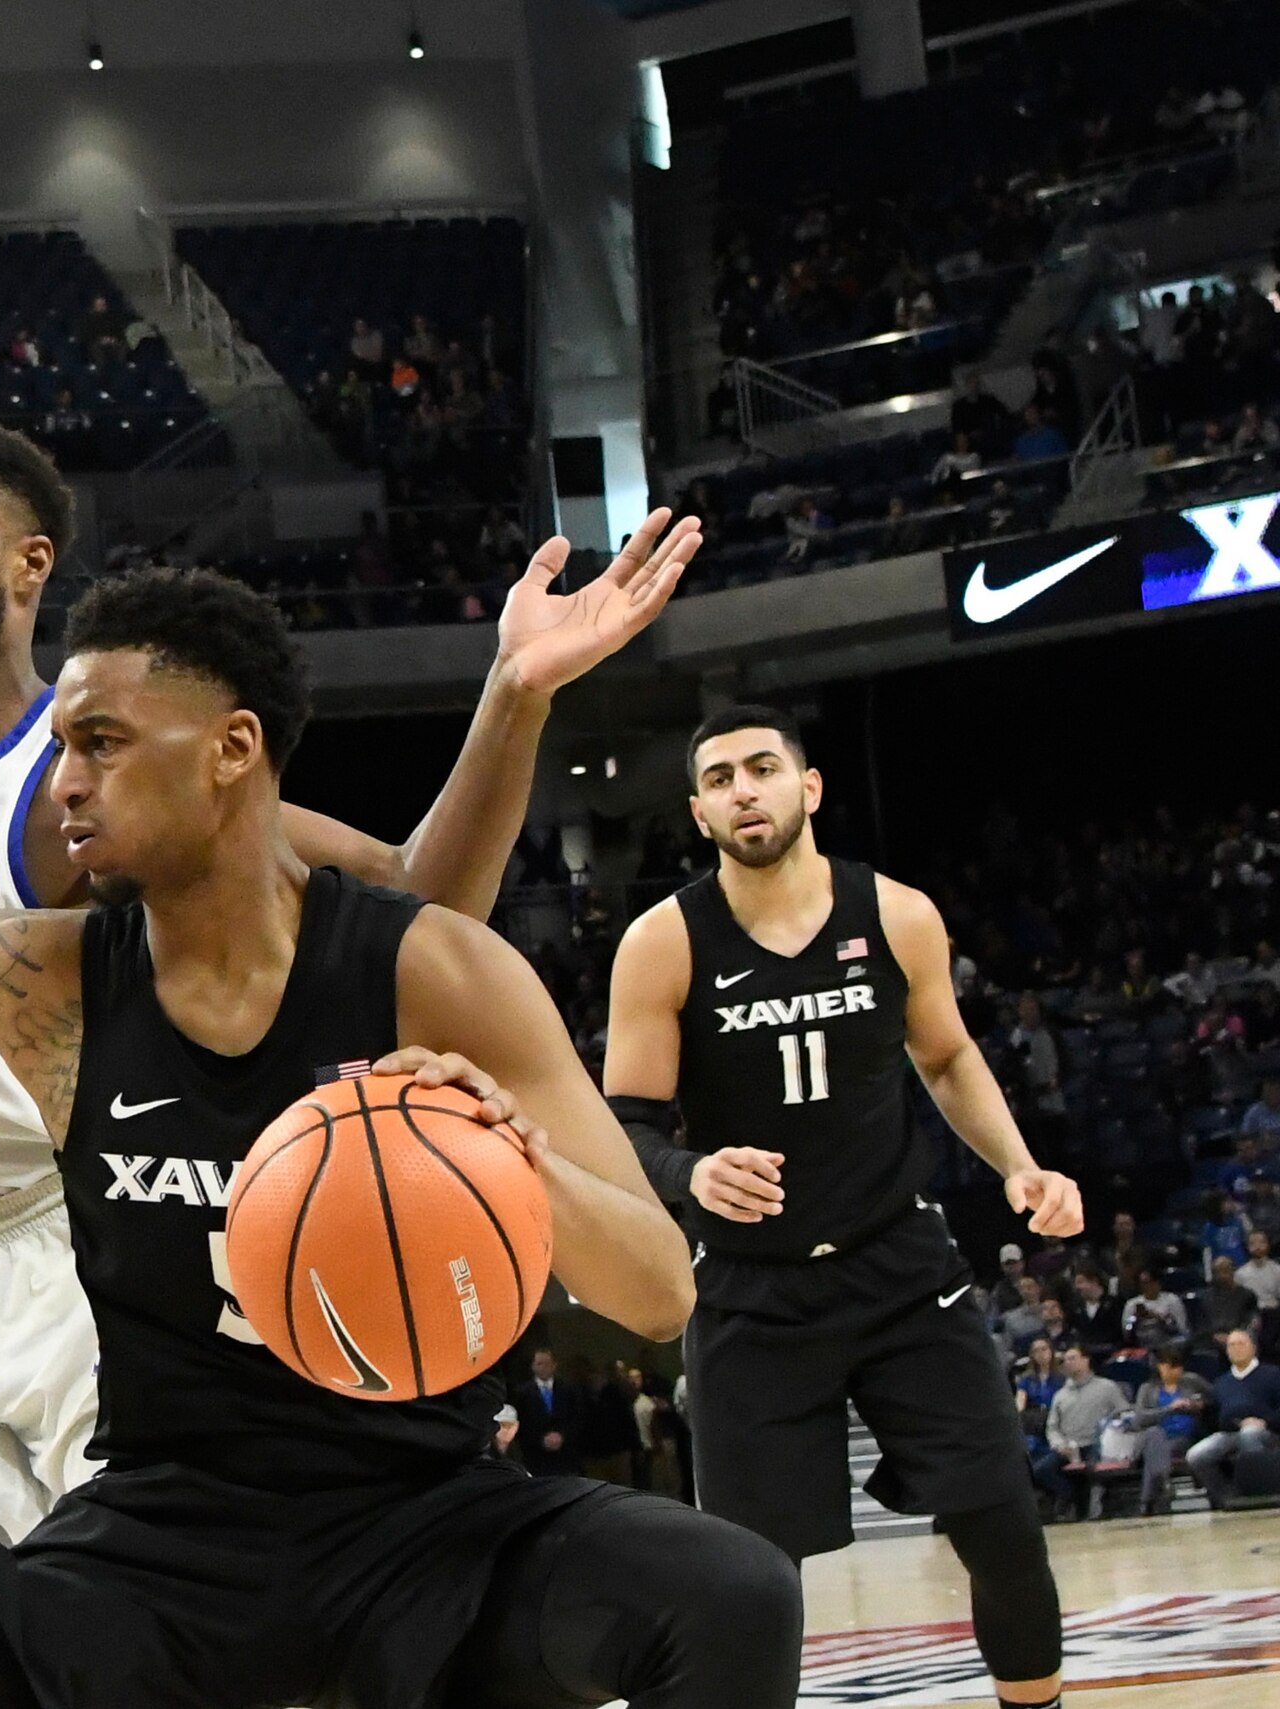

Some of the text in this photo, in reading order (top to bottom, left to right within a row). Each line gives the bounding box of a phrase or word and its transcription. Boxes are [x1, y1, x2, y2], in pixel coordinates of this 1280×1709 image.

[713, 984, 878, 1033] XAVIER
[777, 1030, 830, 1105] 11
[98, 1152, 246, 1208] XAV
